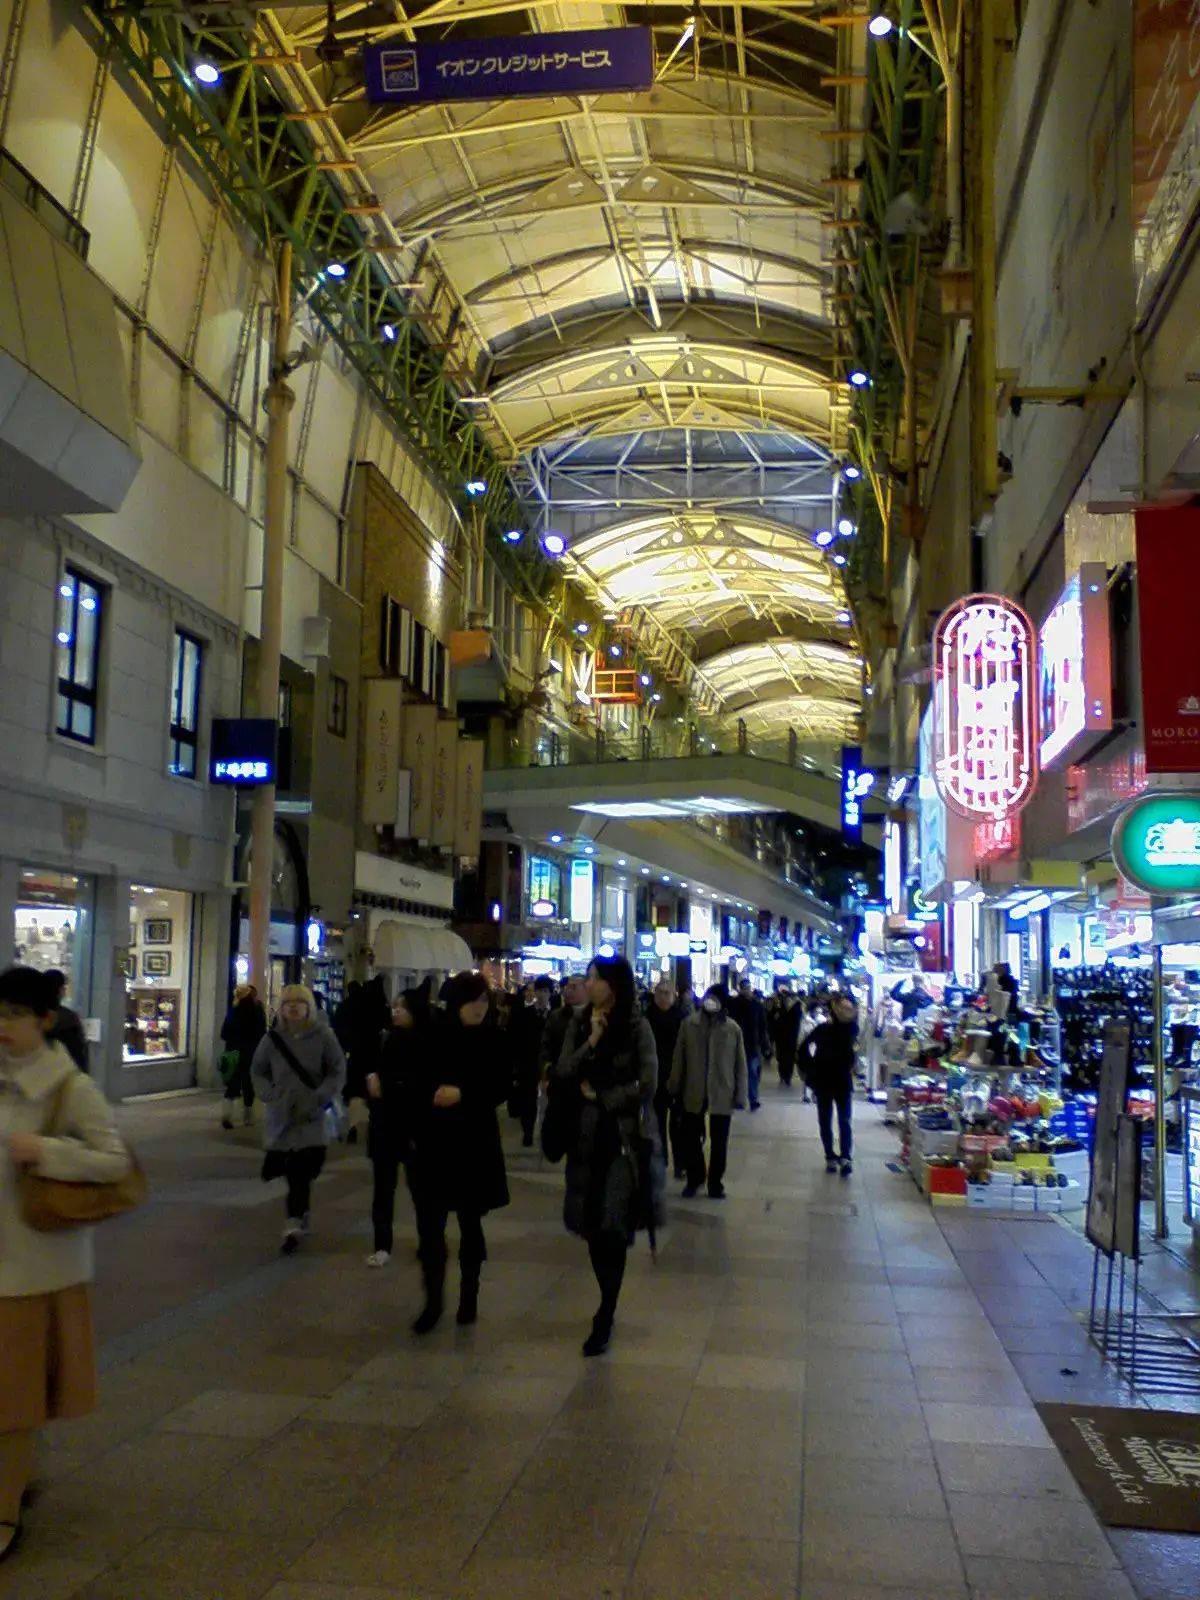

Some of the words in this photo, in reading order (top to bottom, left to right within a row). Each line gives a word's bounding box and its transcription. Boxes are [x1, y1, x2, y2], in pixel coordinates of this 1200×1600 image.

[436, 50, 612, 77] イオンクレジットサービス
